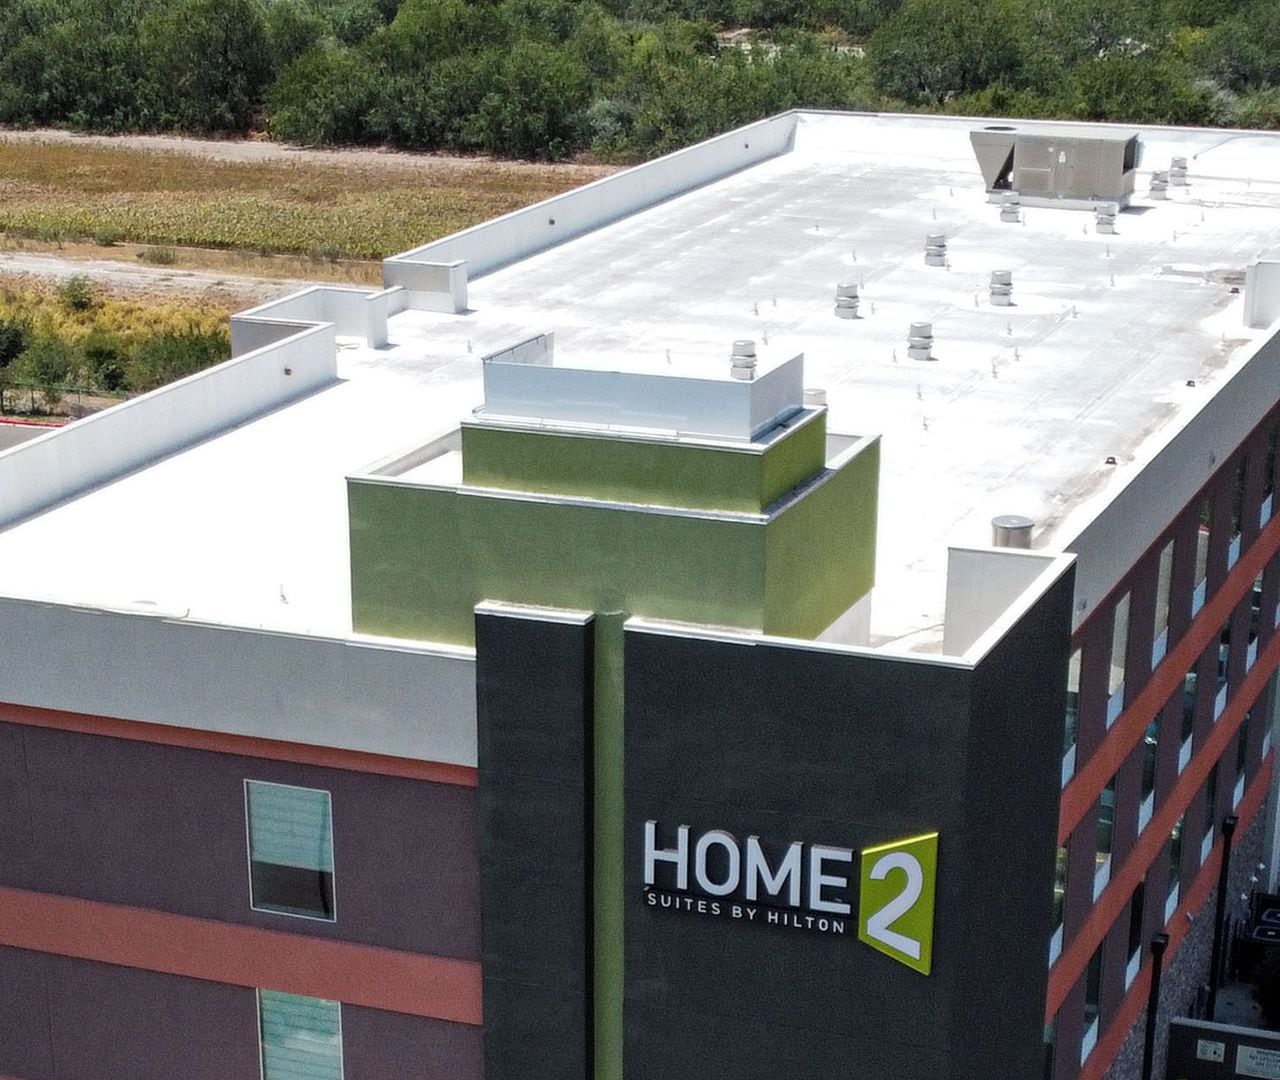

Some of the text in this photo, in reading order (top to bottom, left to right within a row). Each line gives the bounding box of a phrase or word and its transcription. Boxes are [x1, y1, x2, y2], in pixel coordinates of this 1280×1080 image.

[644, 820, 924, 961] HOME 2
[647, 892, 846, 935] SUITES BY HILTON
